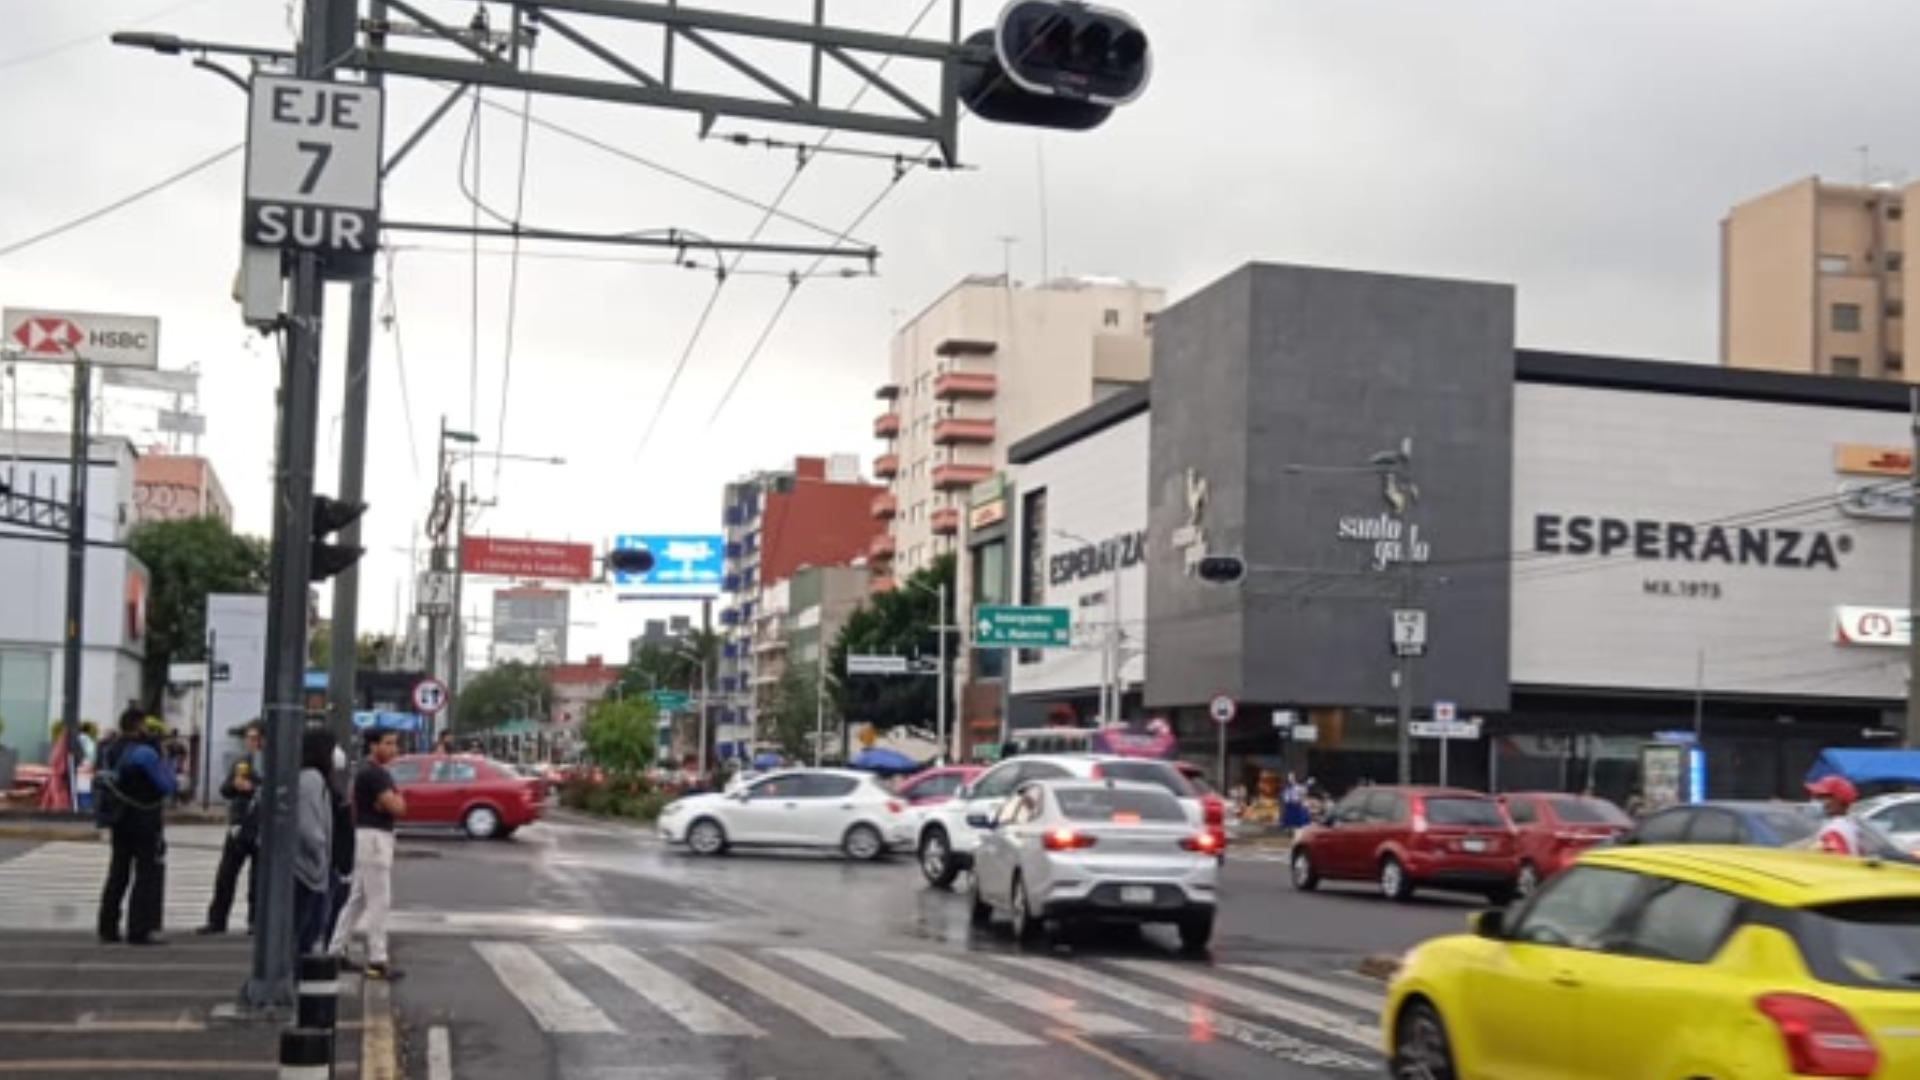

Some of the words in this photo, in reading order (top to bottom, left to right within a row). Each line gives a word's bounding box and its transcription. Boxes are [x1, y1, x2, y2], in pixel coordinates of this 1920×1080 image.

[272, 86, 362, 130] EJE
[298, 141, 333, 194] 7
[256, 205, 365, 249] SUR
[89, 330, 148, 349] HSBC
[1372, 524, 1430, 572] galo
